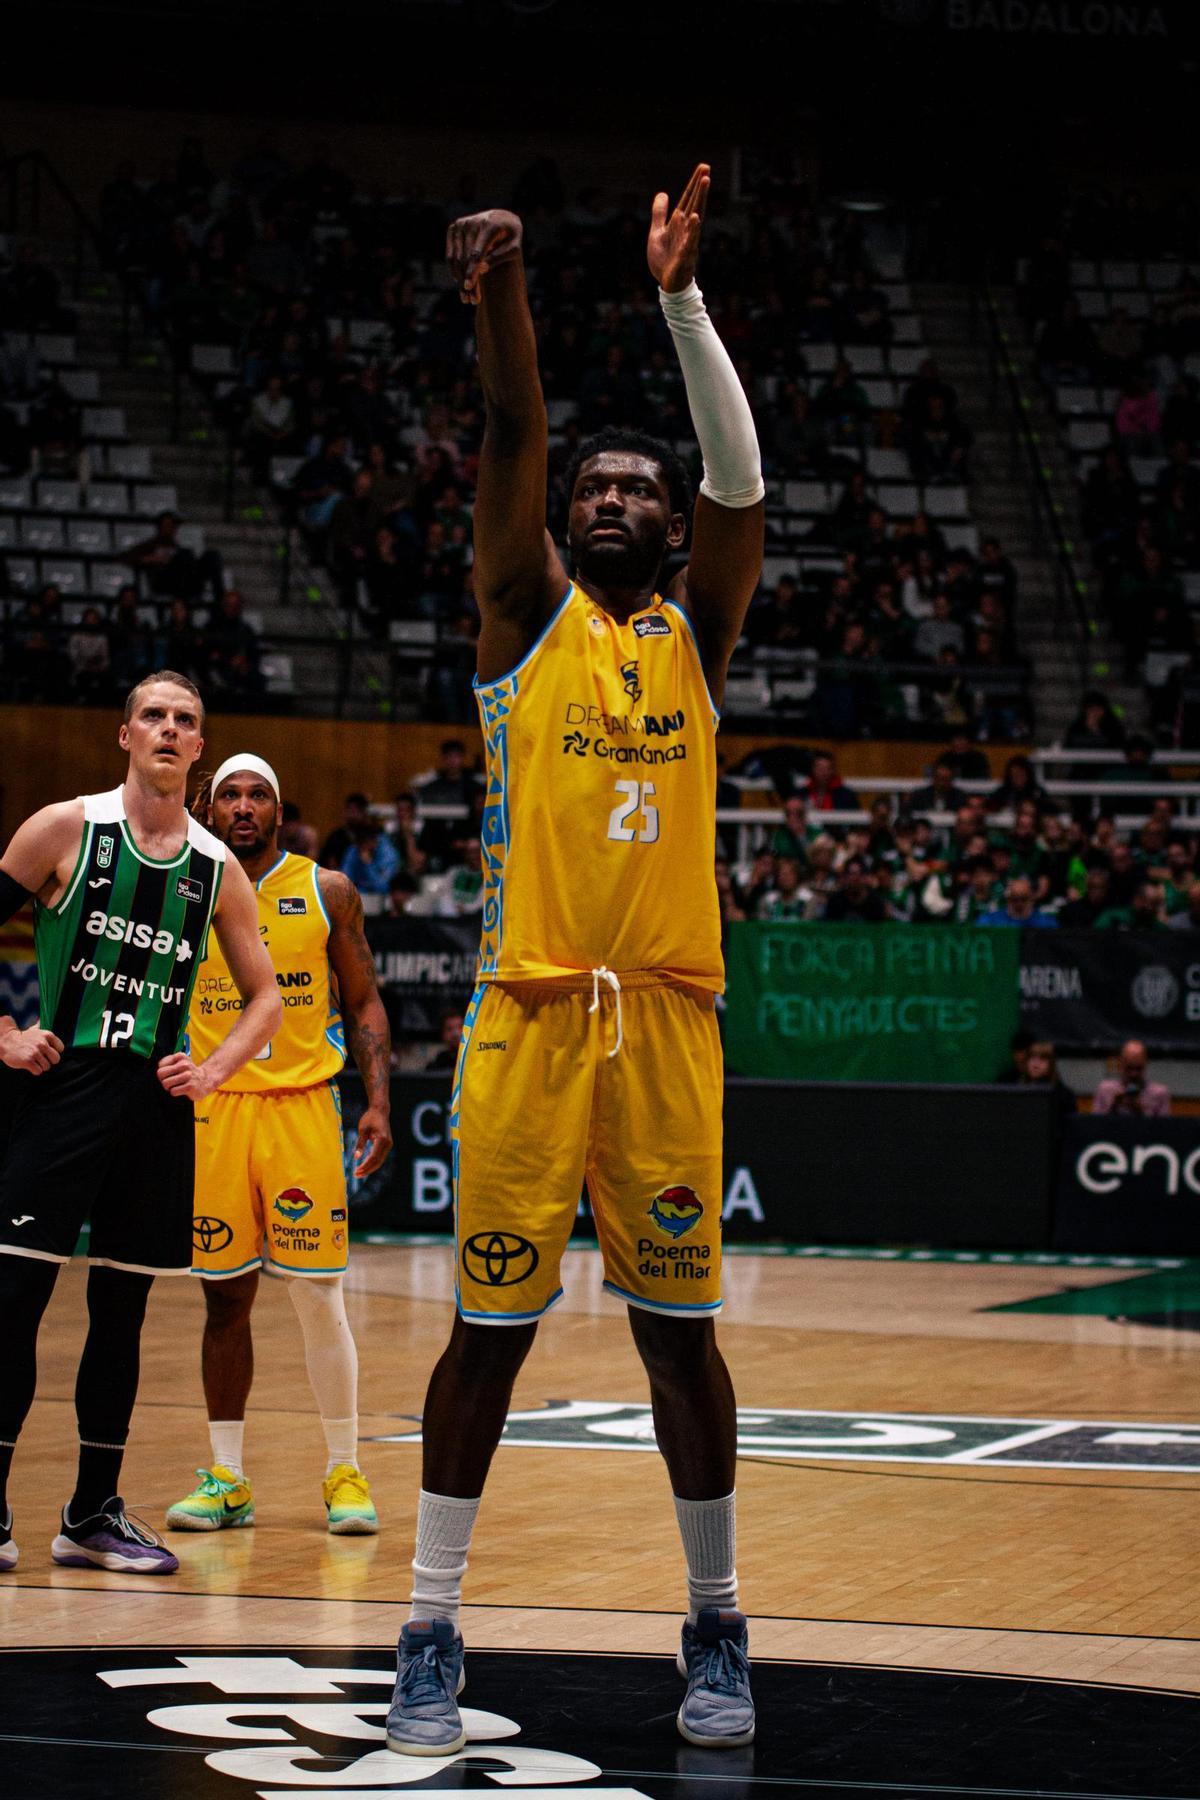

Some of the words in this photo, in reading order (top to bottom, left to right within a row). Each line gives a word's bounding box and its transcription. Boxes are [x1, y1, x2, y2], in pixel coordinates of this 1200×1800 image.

[607, 779, 660, 844] 25
[71, 958, 185, 1005] JOVENTUT
[100, 1010, 135, 1048] 12
[272, 1224, 320, 1237] Poema
[275, 1239, 289, 1250] del
[293, 1239, 320, 1251] Mar
[638, 1239, 711, 1260] Poema
[638, 1260, 667, 1278] del
[674, 1261, 711, 1279] Mar
